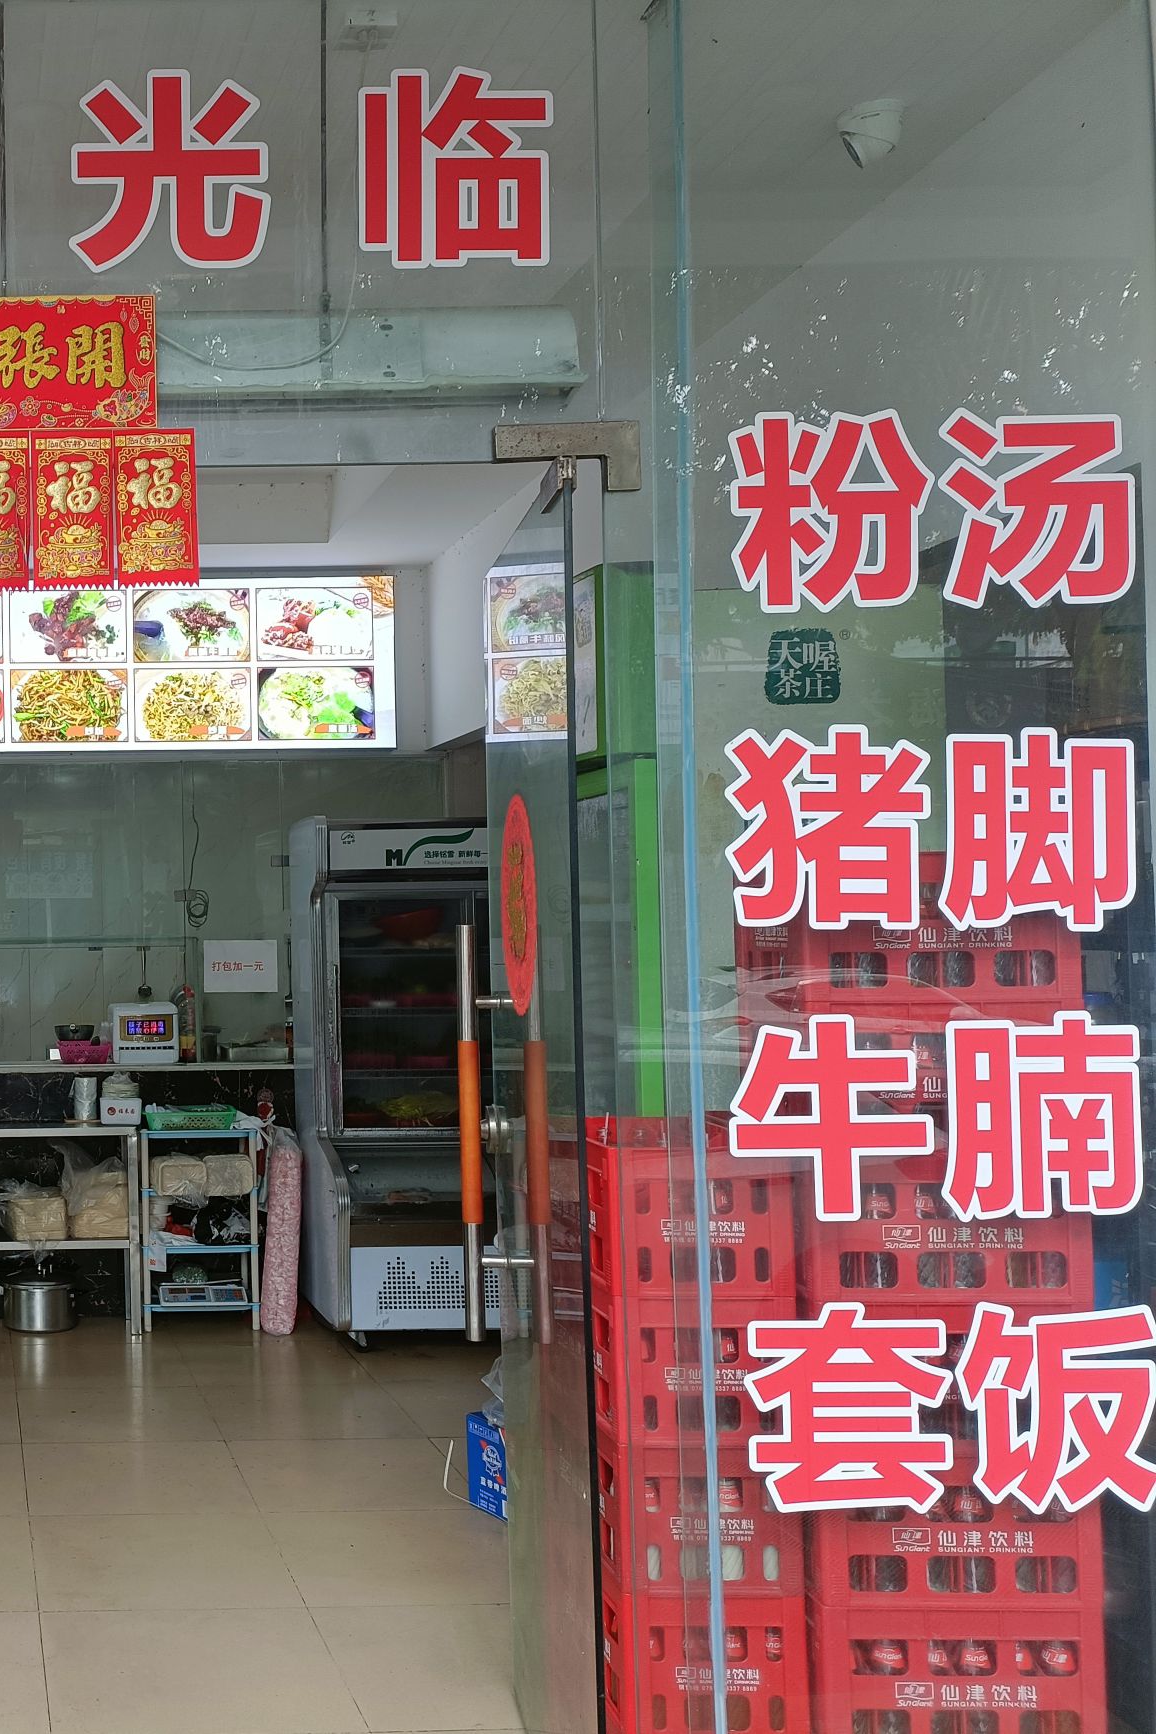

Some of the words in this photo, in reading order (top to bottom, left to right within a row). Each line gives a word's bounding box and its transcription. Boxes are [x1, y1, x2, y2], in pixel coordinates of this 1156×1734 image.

[46, 460, 102, 514] 福
[127, 456, 182, 510] 福
[728, 409, 1137, 613] 粉汤
[774, 668, 833, 699] 茶庄
[725, 724, 1136, 931] 猪脚
[918, 926, 1013, 942] 仙津饮料
[211, 960, 264, 972] 打包加一元
[729, 1011, 1144, 1222] 牛腩
[927, 1226, 1025, 1243] 仙津饮料
[744, 1301, 1156, 1514] 套饭
[893, 1544, 931, 1552] SunGiant
[938, 1530, 1035, 1547] 仙津饮料
[896, 1699, 934, 1707] SunGiant
[941, 1684, 1037, 1701] 仙津饮料
